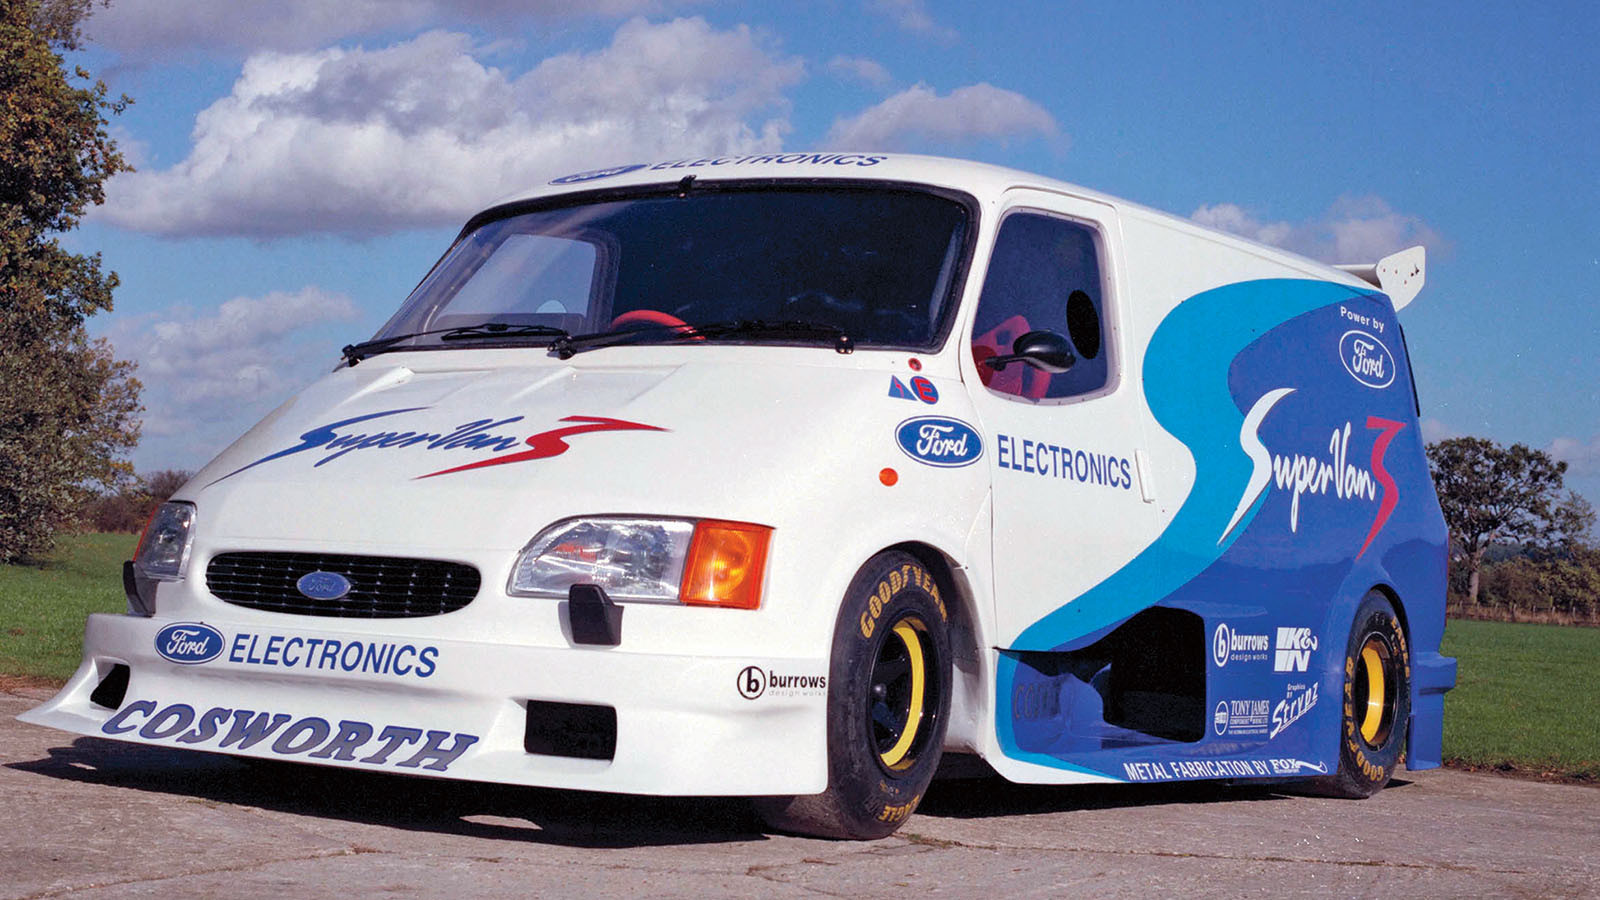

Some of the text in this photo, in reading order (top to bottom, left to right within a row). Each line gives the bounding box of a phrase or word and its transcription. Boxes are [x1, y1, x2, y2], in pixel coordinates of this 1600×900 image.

[1340, 306, 1385, 333] Power by
[1352, 339, 1385, 378] Ford
[916, 424, 968, 457] Ford
[997, 434, 1132, 490] ELECTRONICS
[860, 564, 947, 639] GOODYEAR
[166, 628, 211, 656] Ford
[1231, 628, 1269, 651] burrows
[229, 633, 439, 678] ELECTRONICS
[1231, 653, 1251, 662] design
[769, 670, 826, 688] burrows
[1231, 700, 1250, 716] TONY
[1249, 700, 1270, 721] JAMES
[101, 700, 479, 773] COSWORTH
[1123, 758, 1300, 780] METAL FABRICATION BY FOX
